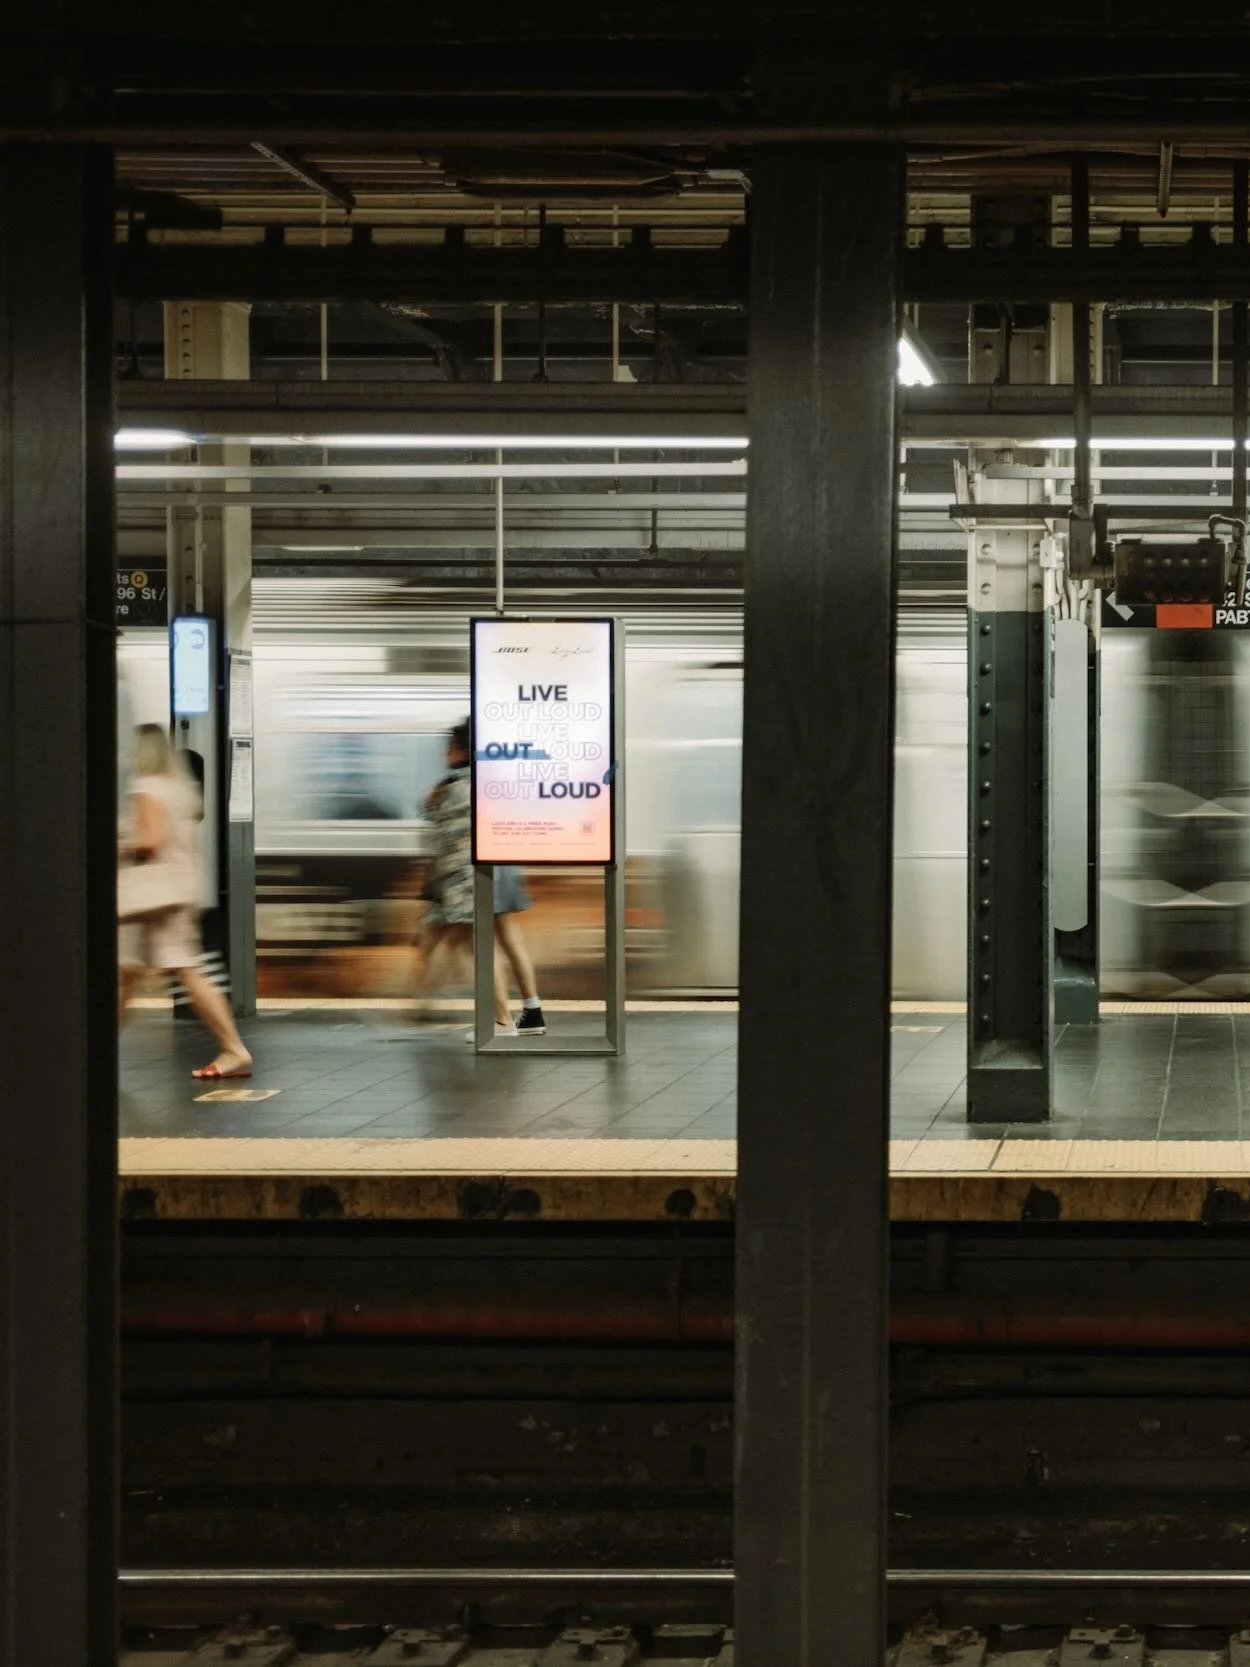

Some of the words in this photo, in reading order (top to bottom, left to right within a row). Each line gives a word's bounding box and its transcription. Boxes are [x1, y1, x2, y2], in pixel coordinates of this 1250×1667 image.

[116, 587, 136, 600] 96
[518, 684, 568, 701] LIVE
[484, 701, 534, 721] OUT
[540, 701, 602, 721] LOUD
[518, 722, 570, 741] LIVE
[485, 742, 533, 759] OUT
[518, 762, 569, 781] LIVE
[484, 780, 534, 800] OUT
[539, 781, 601, 799] LOUD
